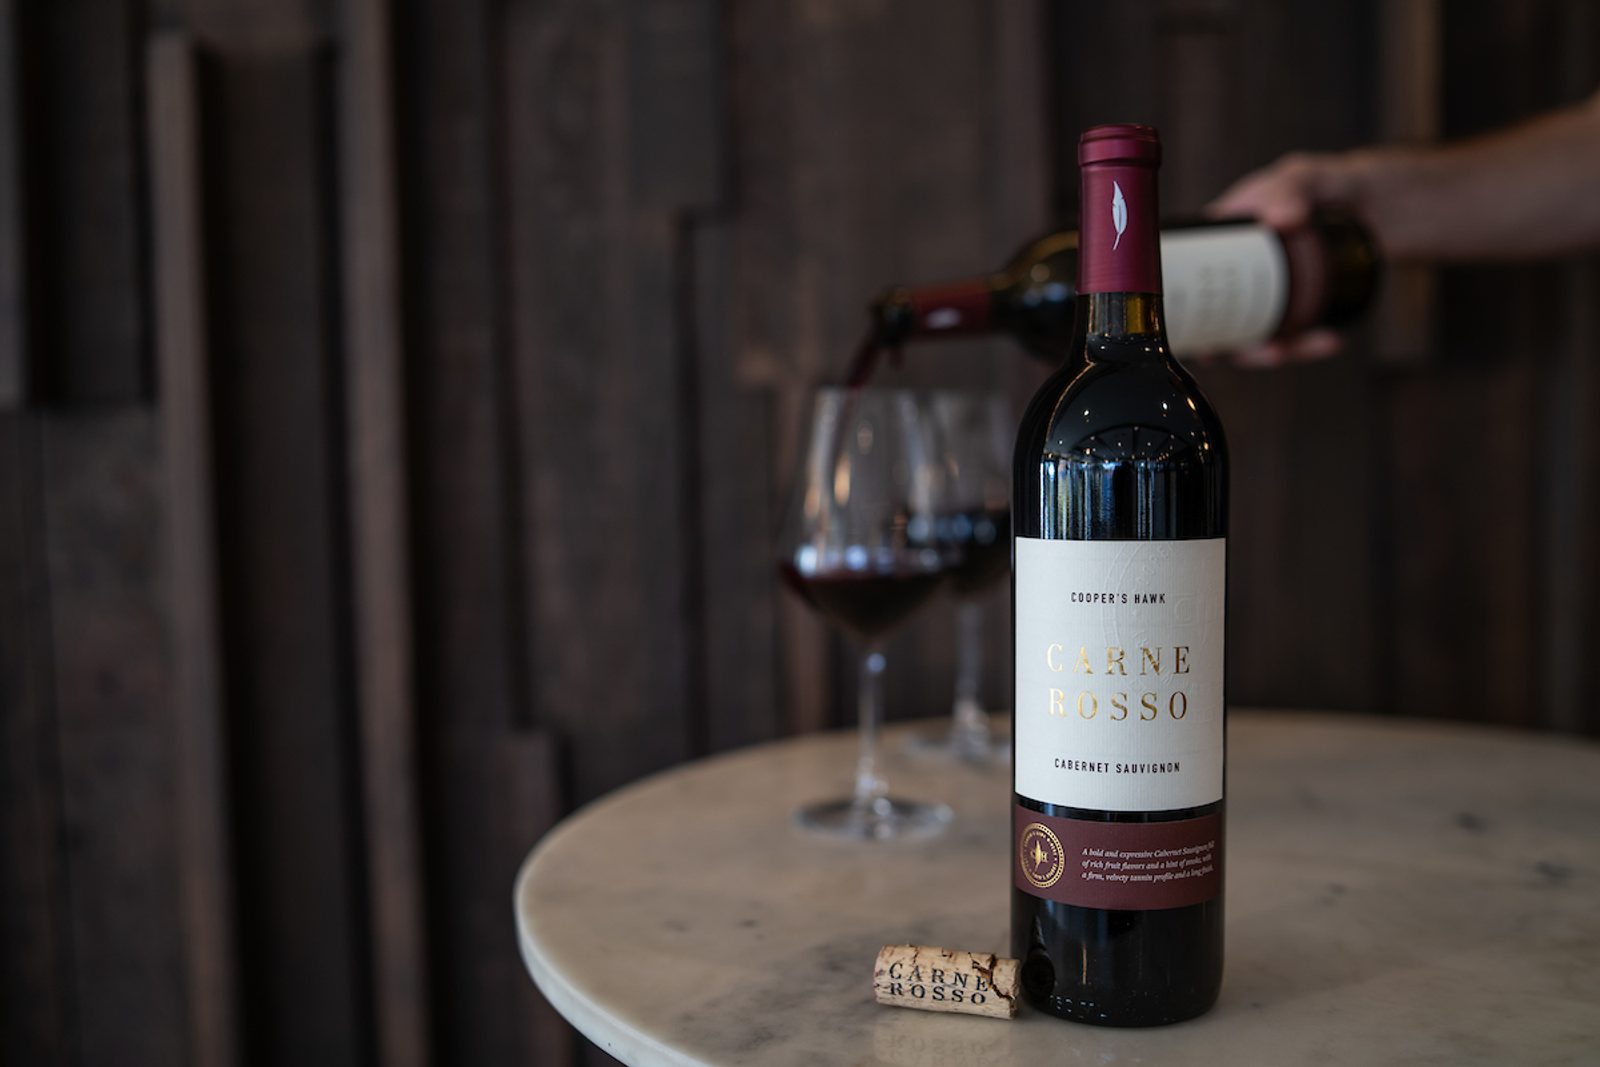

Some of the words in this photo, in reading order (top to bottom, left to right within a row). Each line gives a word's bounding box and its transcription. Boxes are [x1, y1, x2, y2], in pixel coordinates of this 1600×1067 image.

[1070, 591, 1128, 604] COOPER'S
[1134, 592, 1166, 604] HAWK
[1046, 642, 1191, 676] CARNE
[1047, 687, 1188, 721] ROSSO
[1054, 758, 1109, 773] CABERNET
[1115, 761, 1180, 774] SAUVIGNON
[1081, 848, 1088, 856] A
[1089, 848, 1105, 857] bold
[1104, 850, 1119, 858] and
[1119, 850, 1153, 860] expressive
[1153, 849, 1182, 858] Cabernet
[1081, 859, 1090, 869] of
[1090, 860, 1104, 869] rich
[1103, 861, 1121, 871] fruit
[1120, 861, 1145, 871] flavors
[1145, 861, 1160, 869] and
[1165, 860, 1179, 868] hint
[1178, 858, 1186, 869] of
[1173, 869, 1185, 879] and
[888, 961, 989, 992] CARNE
[889, 982, 986, 1005] ROSSO
